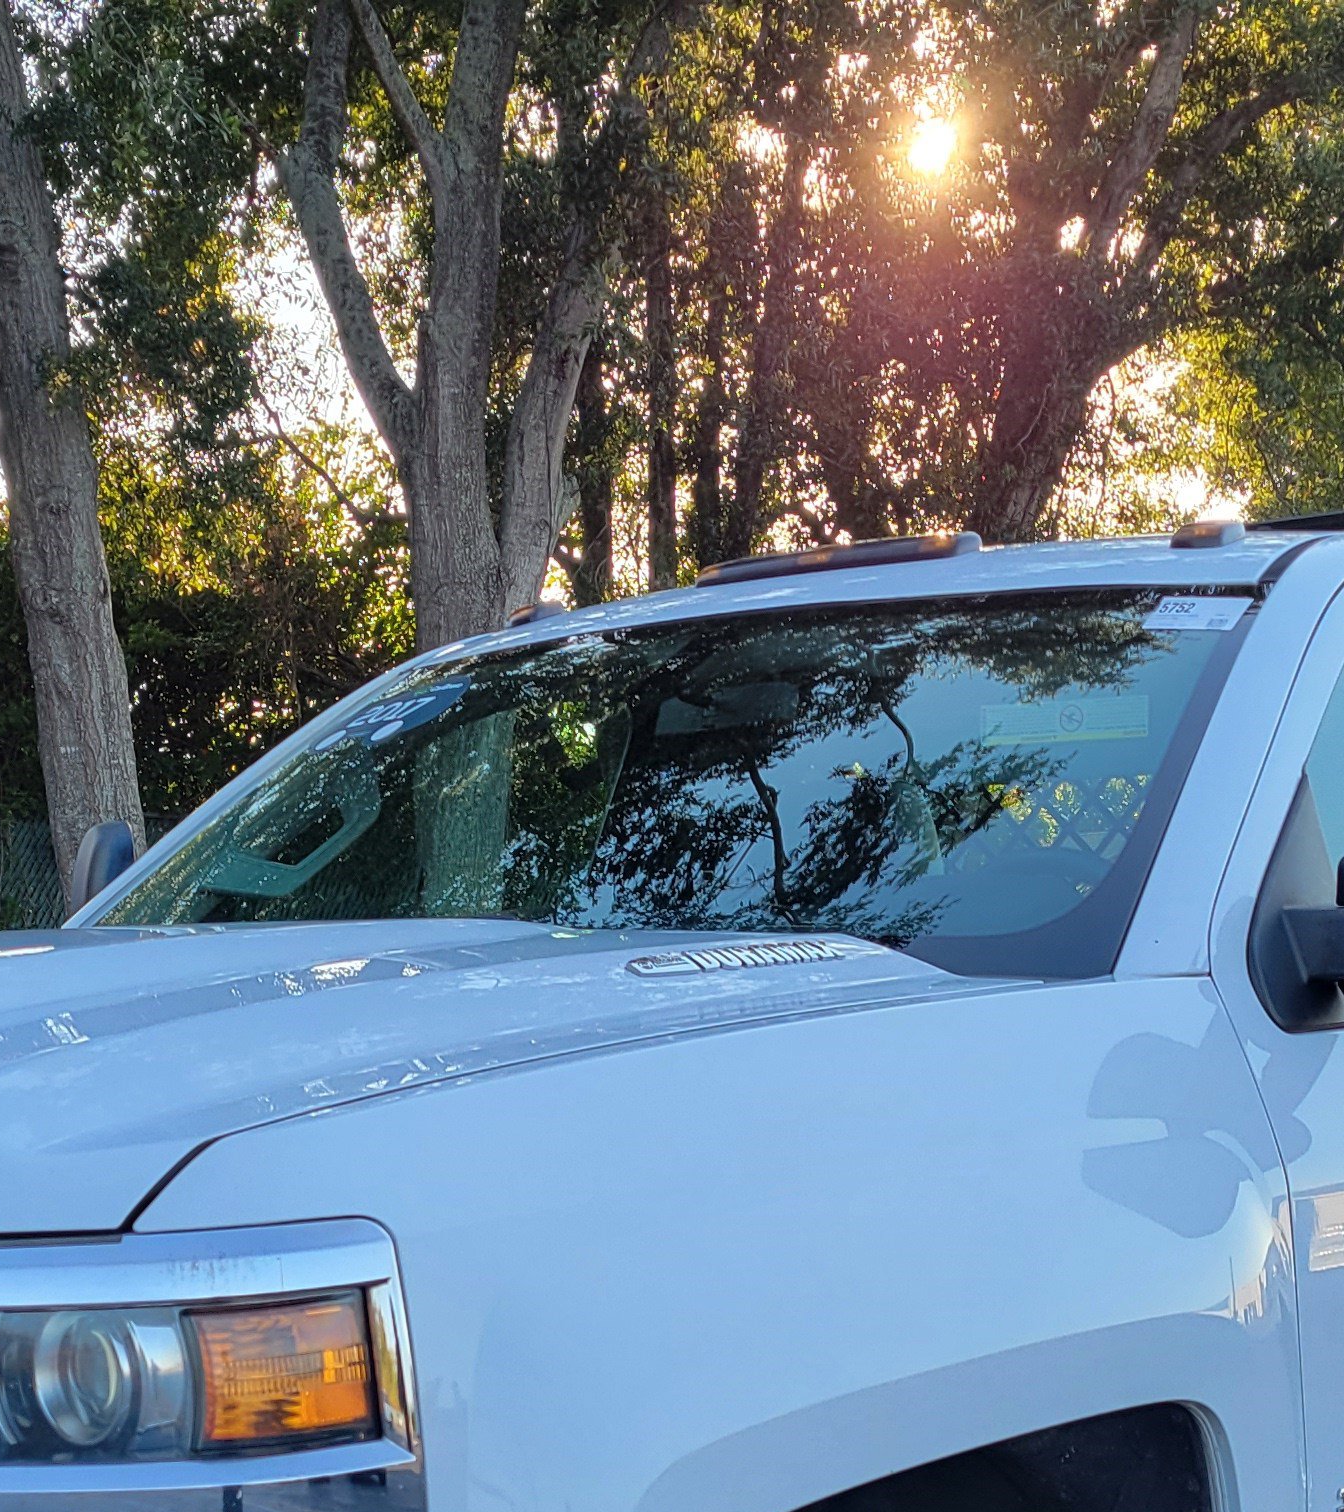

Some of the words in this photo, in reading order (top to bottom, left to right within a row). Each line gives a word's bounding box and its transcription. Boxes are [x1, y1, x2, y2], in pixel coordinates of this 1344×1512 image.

[1159, 602, 1196, 614] 5752
[346, 696, 437, 729] 2017
[683, 940, 846, 973] DURAMAX
